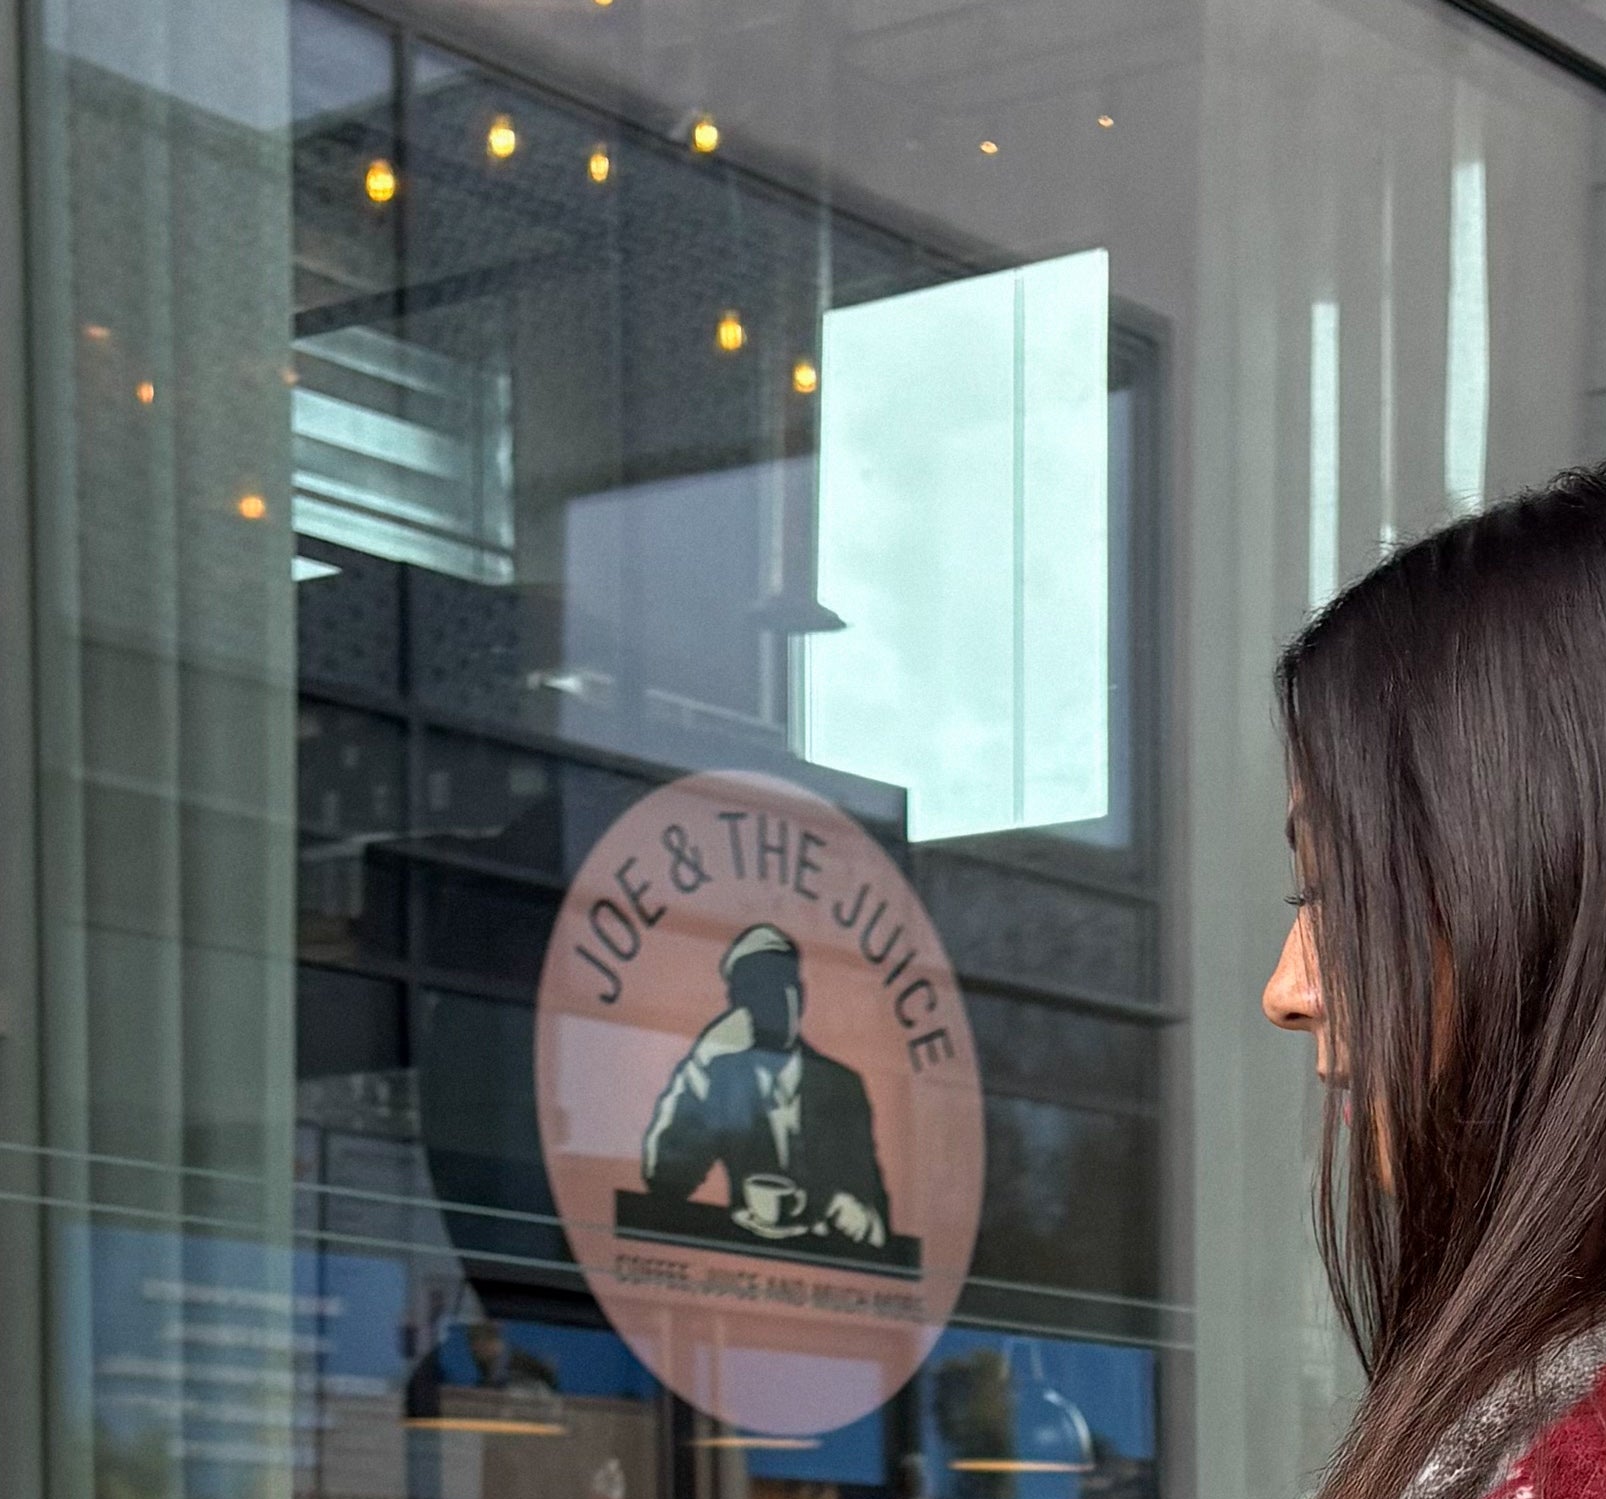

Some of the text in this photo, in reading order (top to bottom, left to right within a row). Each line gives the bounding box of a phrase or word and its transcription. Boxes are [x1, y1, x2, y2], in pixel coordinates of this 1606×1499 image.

[575, 810, 955, 1076] JOE & THE JUICE
